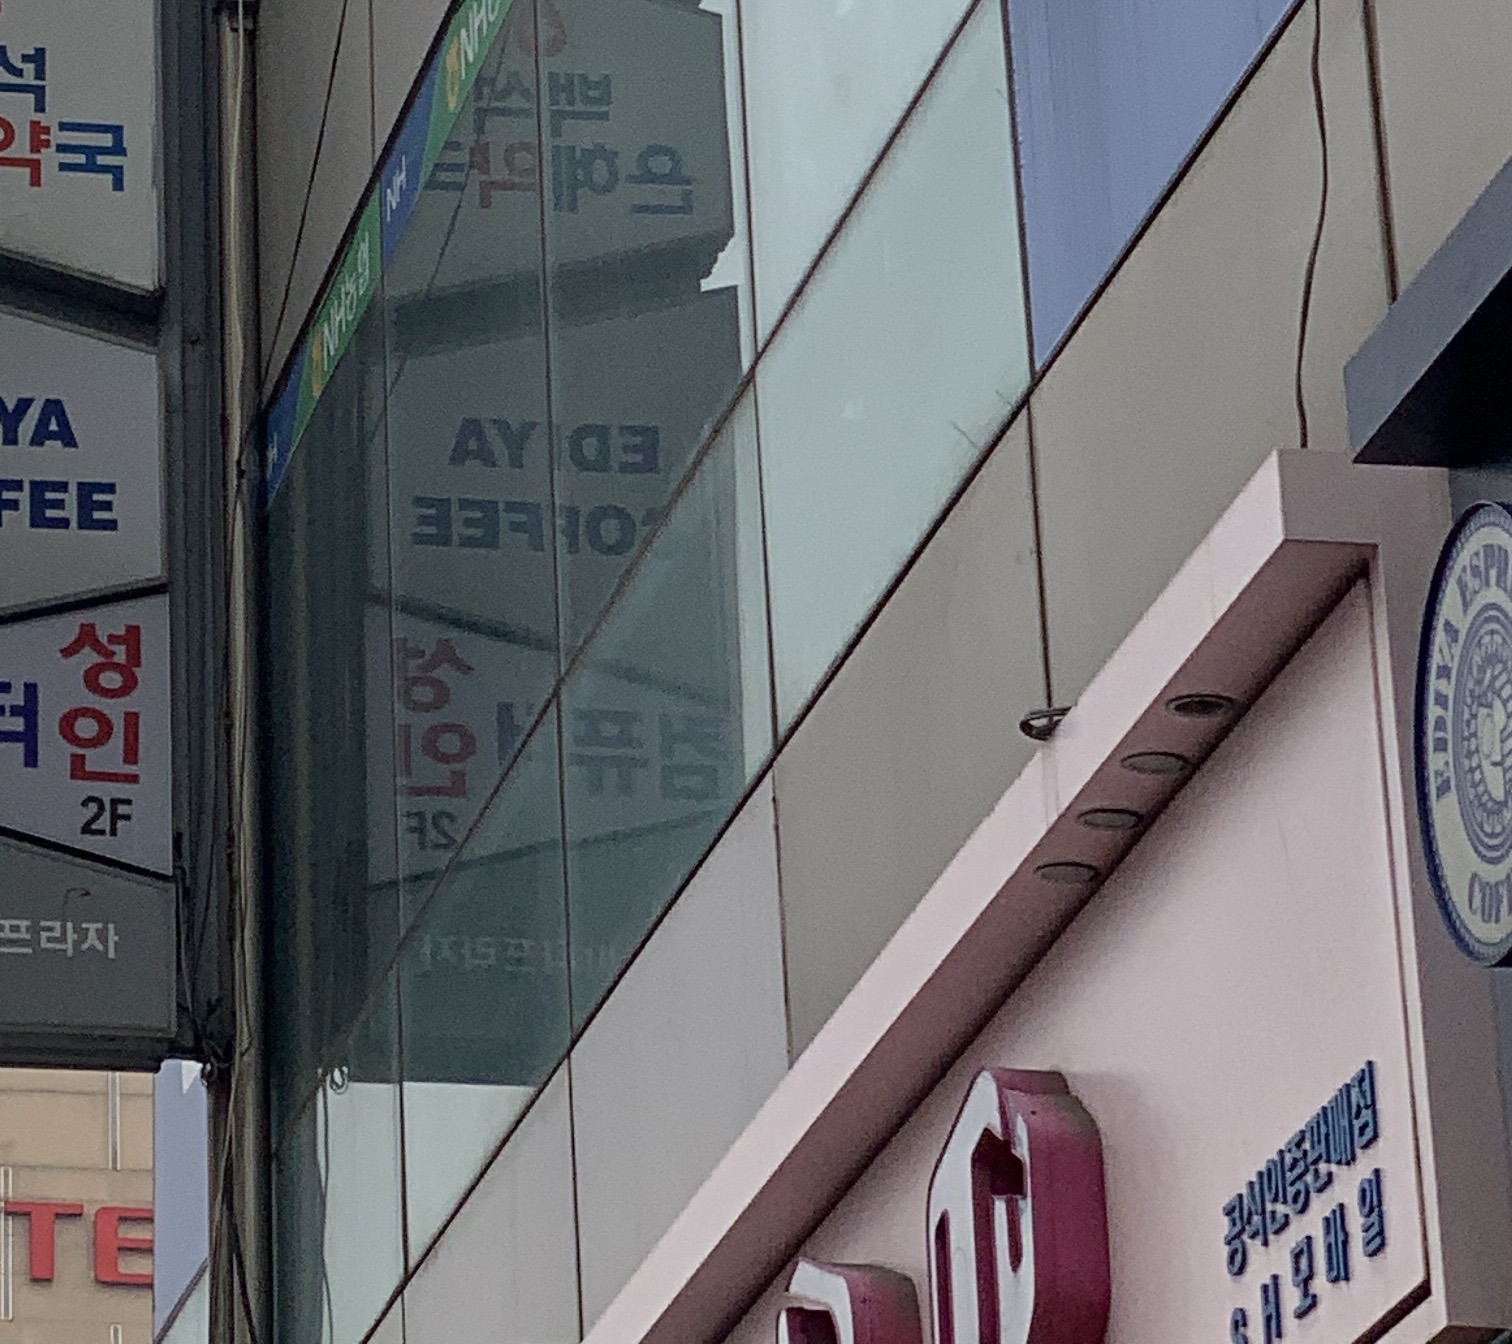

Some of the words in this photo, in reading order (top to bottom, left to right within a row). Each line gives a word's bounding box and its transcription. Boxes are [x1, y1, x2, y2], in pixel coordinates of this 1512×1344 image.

[57, 622, 142, 784] 성인
[79, 796, 133, 837] 2F
[1223, 1059, 1379, 1277] 공식인증판매점
